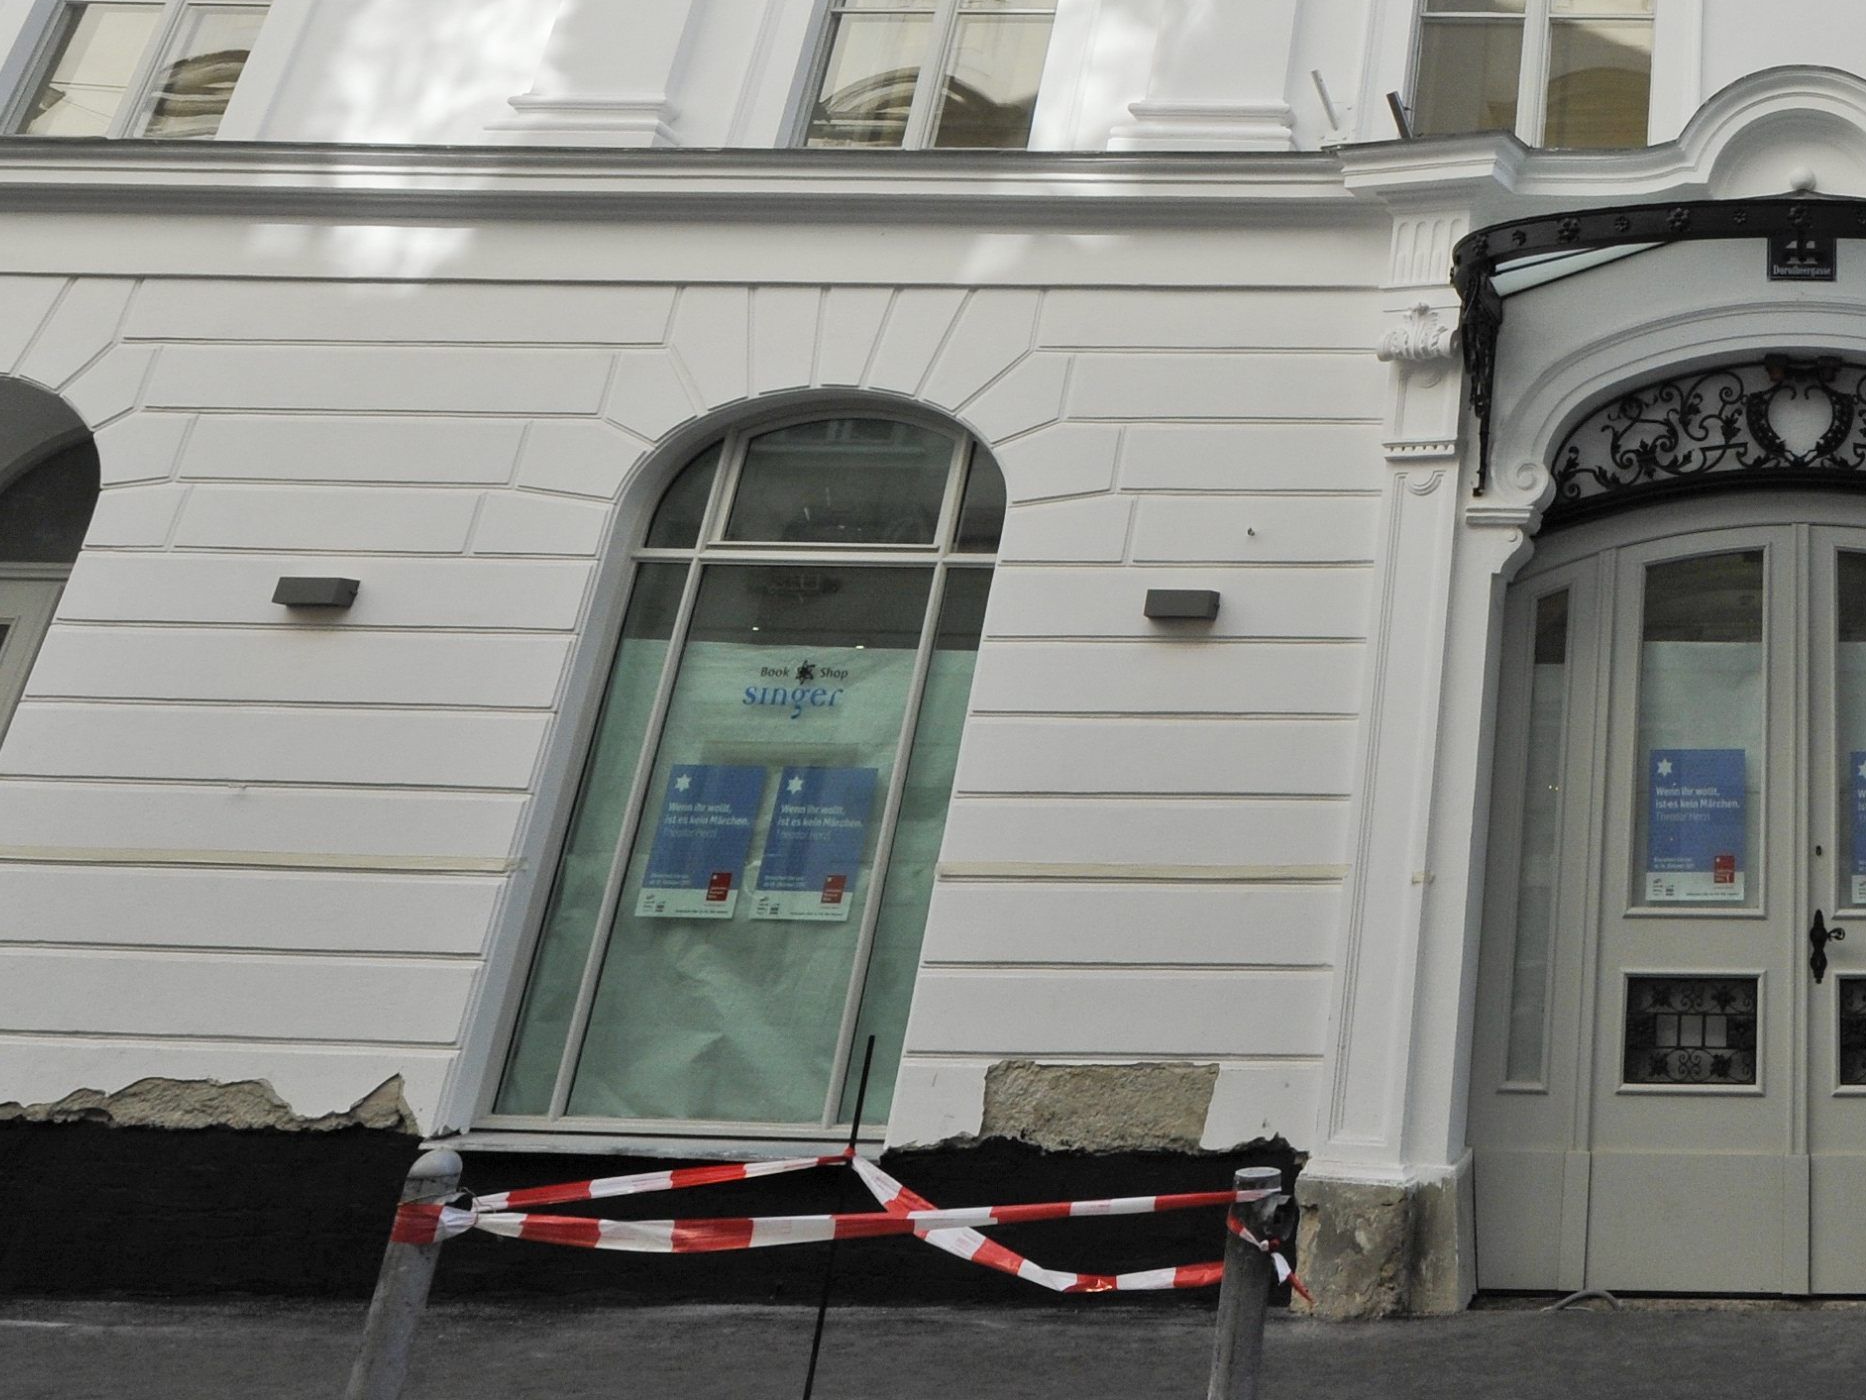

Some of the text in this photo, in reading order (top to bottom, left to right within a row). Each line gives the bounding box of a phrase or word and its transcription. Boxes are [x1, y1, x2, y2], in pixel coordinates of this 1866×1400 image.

[760, 666, 848, 680] Book Shop
[743, 686, 843, 719] singer
[1656, 787, 1680, 796] Wenn
[668, 802, 693, 811] Wenn
[1680, 799, 1698, 808] kein
[1700, 799, 1740, 808] Märchen.
[781, 805, 806, 813] Wenn
